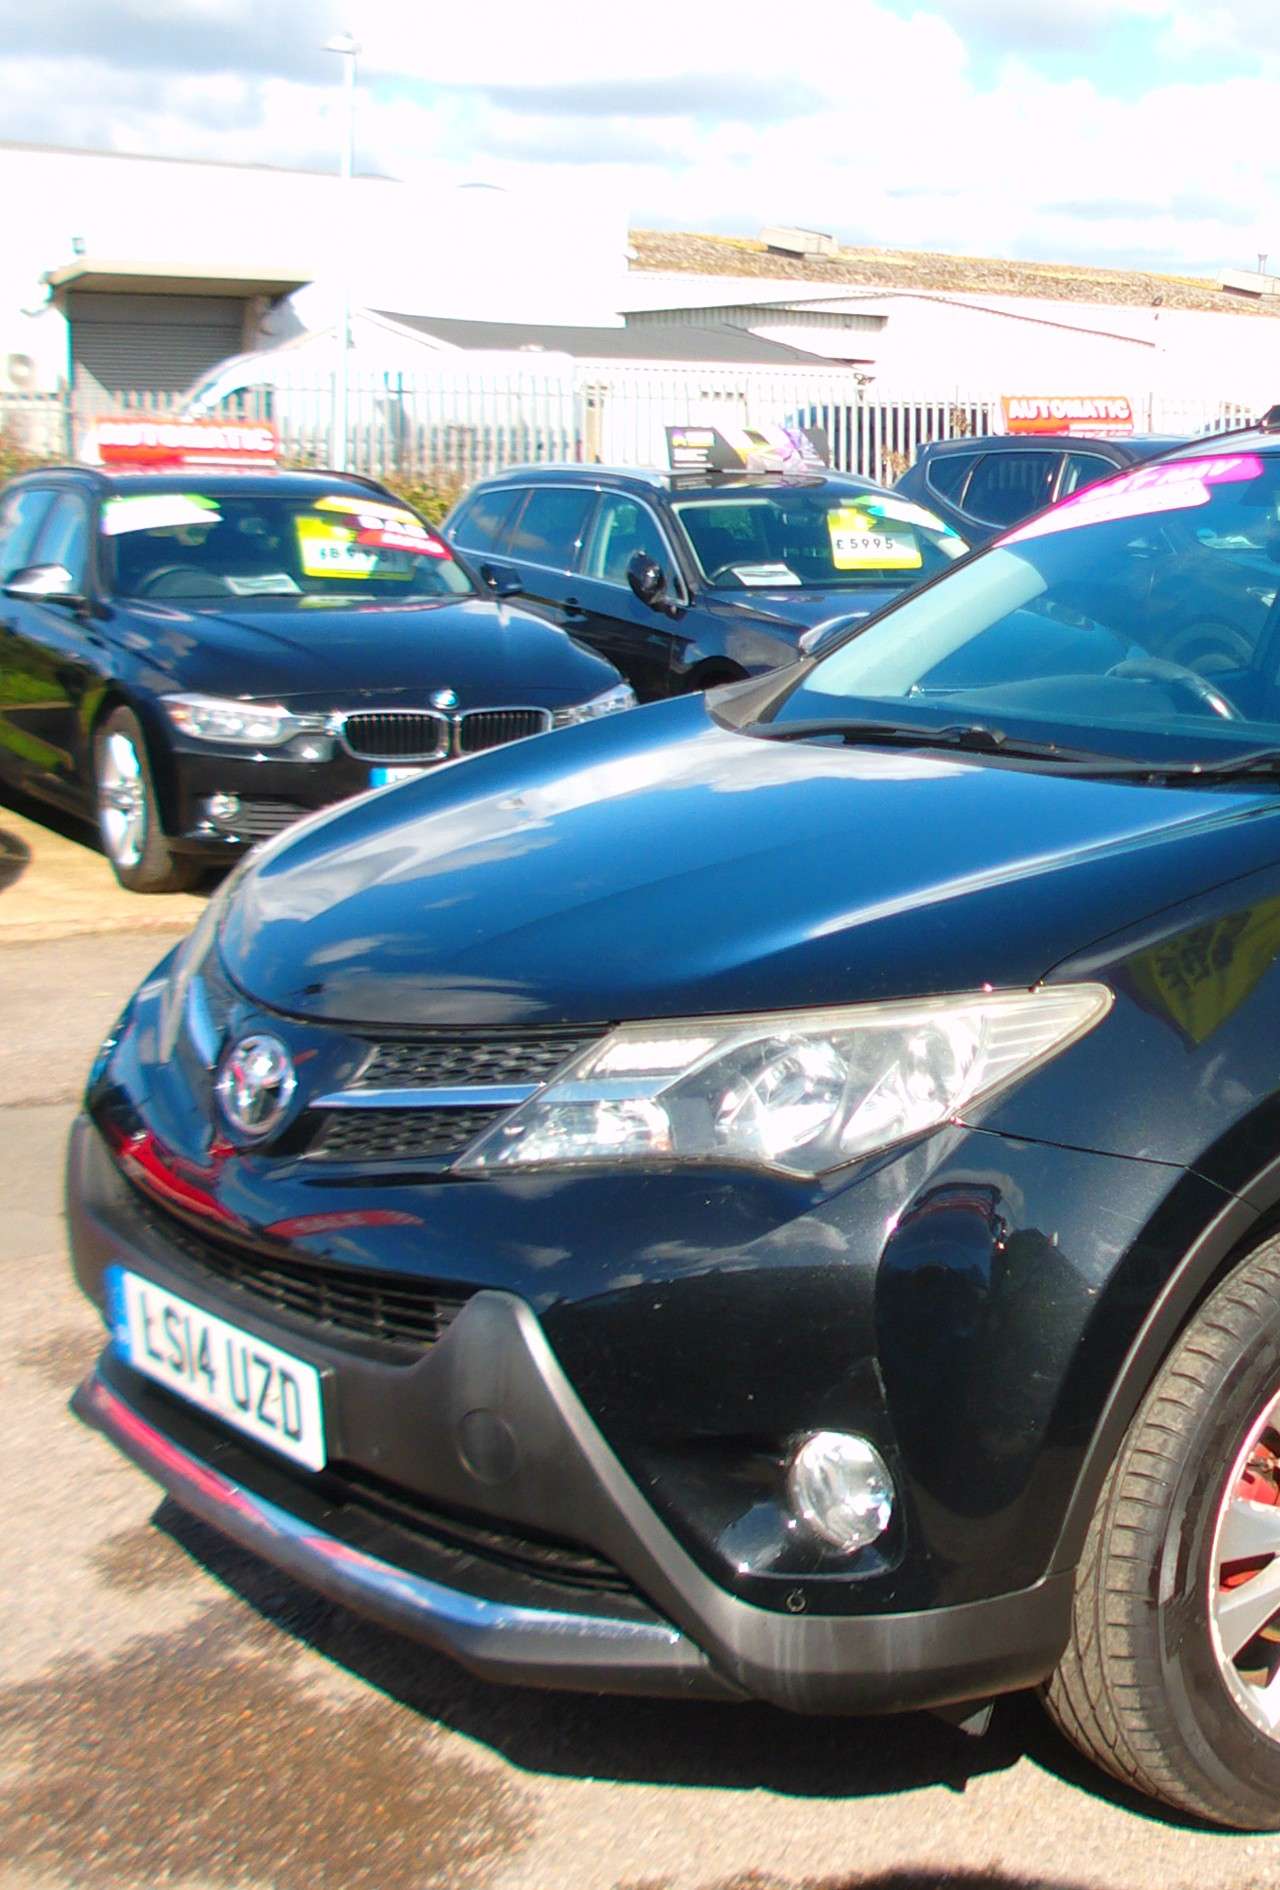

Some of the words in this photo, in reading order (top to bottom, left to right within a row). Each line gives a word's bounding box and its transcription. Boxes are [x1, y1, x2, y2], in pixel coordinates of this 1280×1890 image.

[1008, 398, 1131, 420] AUTOMATIC
[836, 537, 895, 551] £5995
[137, 1291, 217, 1394] LS14
[224, 1338, 304, 1443] UZD
